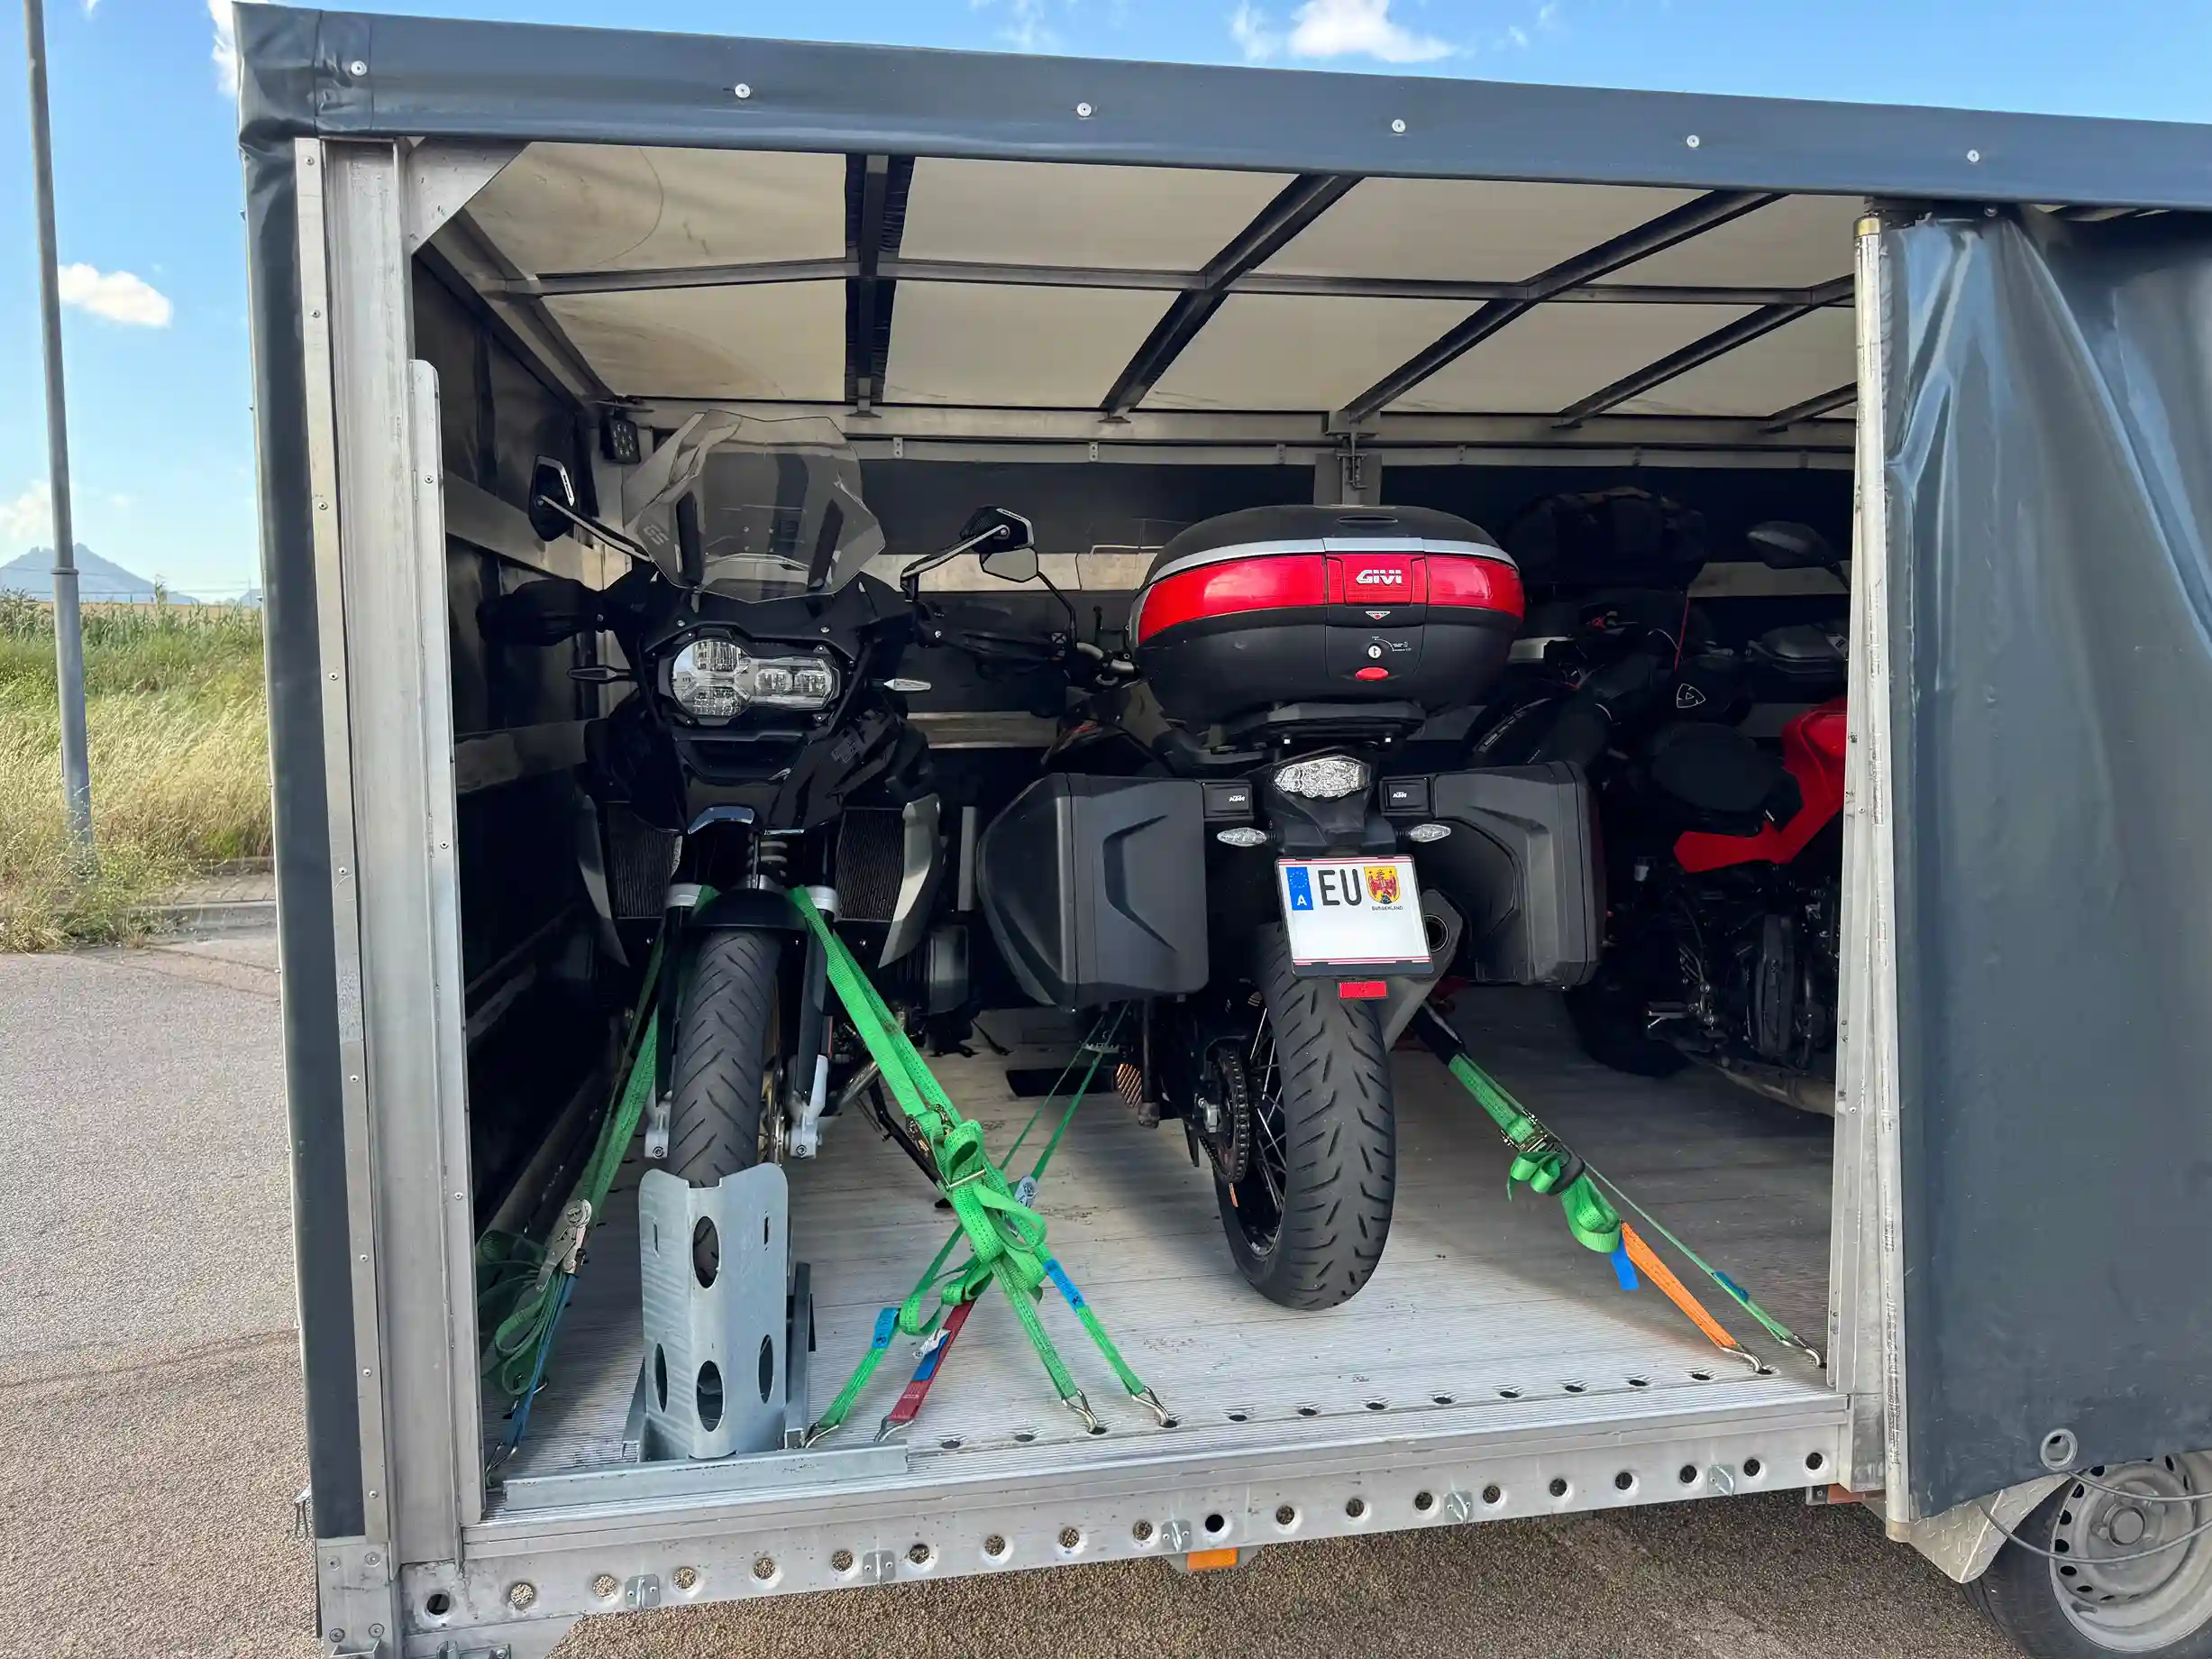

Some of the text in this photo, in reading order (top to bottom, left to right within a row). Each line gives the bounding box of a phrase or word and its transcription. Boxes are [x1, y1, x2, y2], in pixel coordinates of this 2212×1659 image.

[1356, 569, 1403, 585] GIVI
[1317, 868, 1363, 906] EU
[1296, 894, 1308, 906] A
